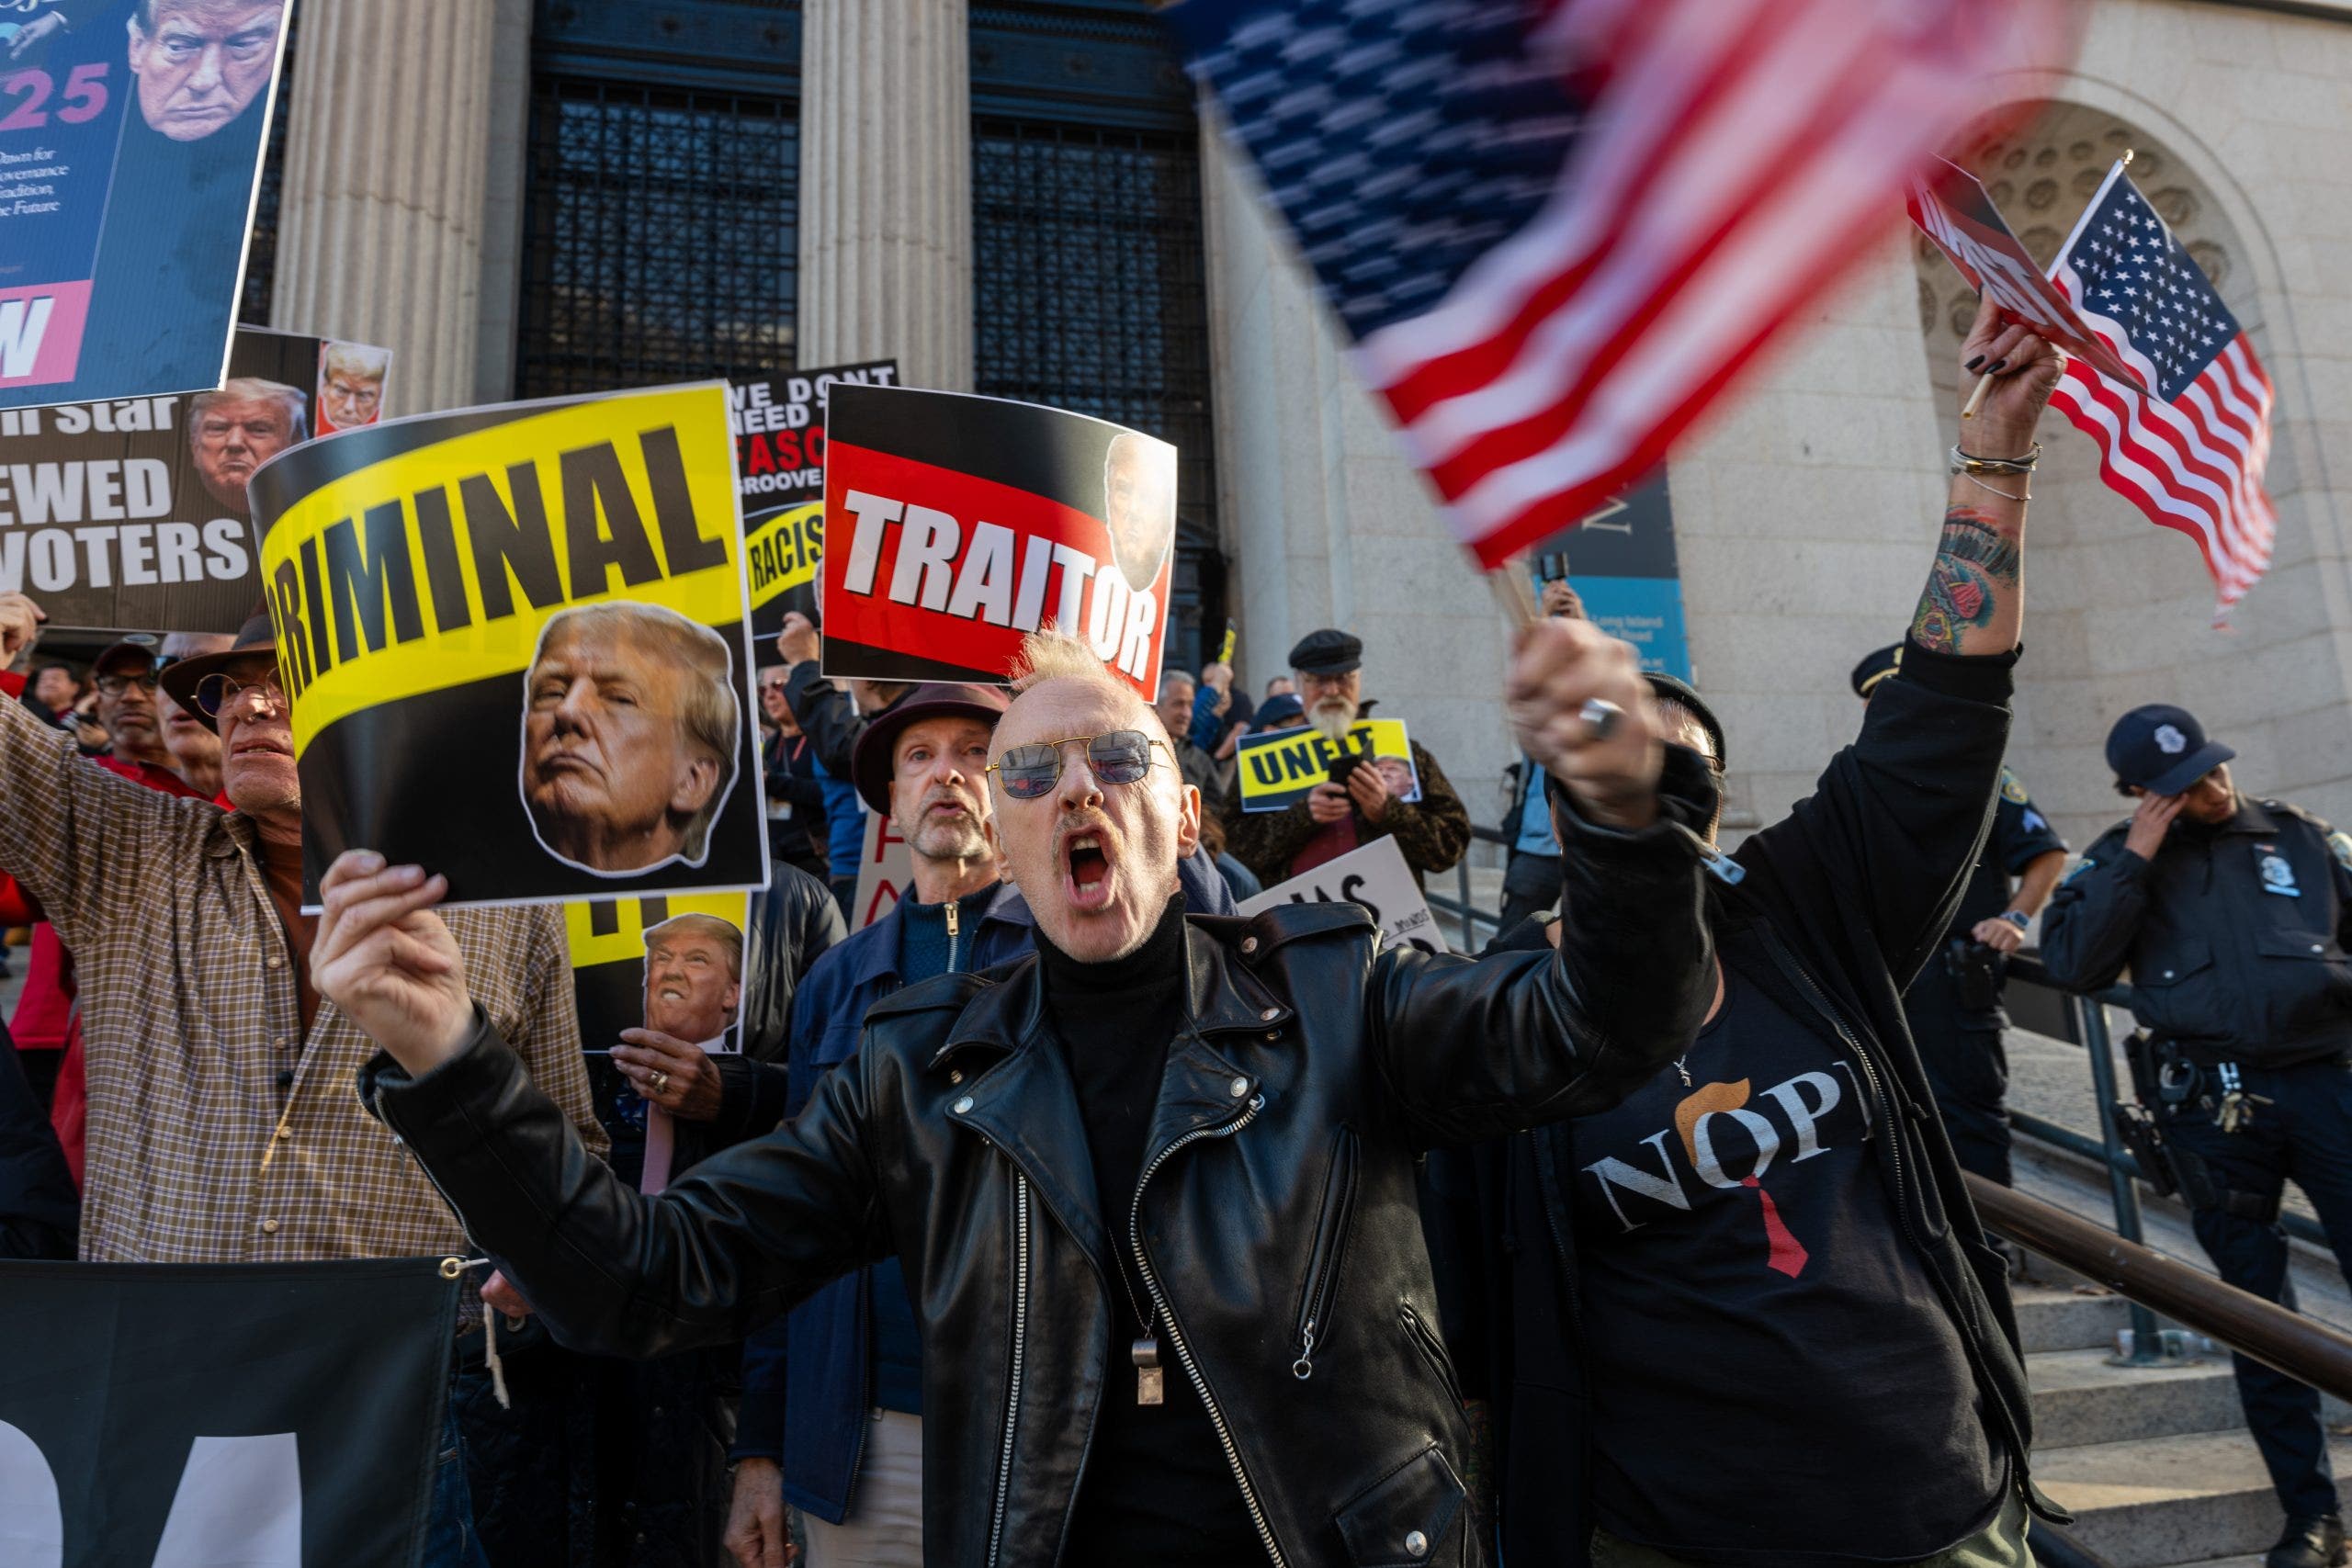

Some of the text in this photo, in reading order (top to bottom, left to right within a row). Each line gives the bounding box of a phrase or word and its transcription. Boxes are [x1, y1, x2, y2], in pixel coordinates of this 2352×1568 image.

[0, 62, 109, 131] 25
[33, 147, 57, 161] for
[13, 199, 61, 215] Future
[735, 425, 825, 475] ASC
[739, 468, 822, 496] ROOVE
[266, 423, 729, 727] CRIMINAL
[843, 489, 1158, 682] TRAITOR
[1581, 1060, 1874, 1234] NOP
